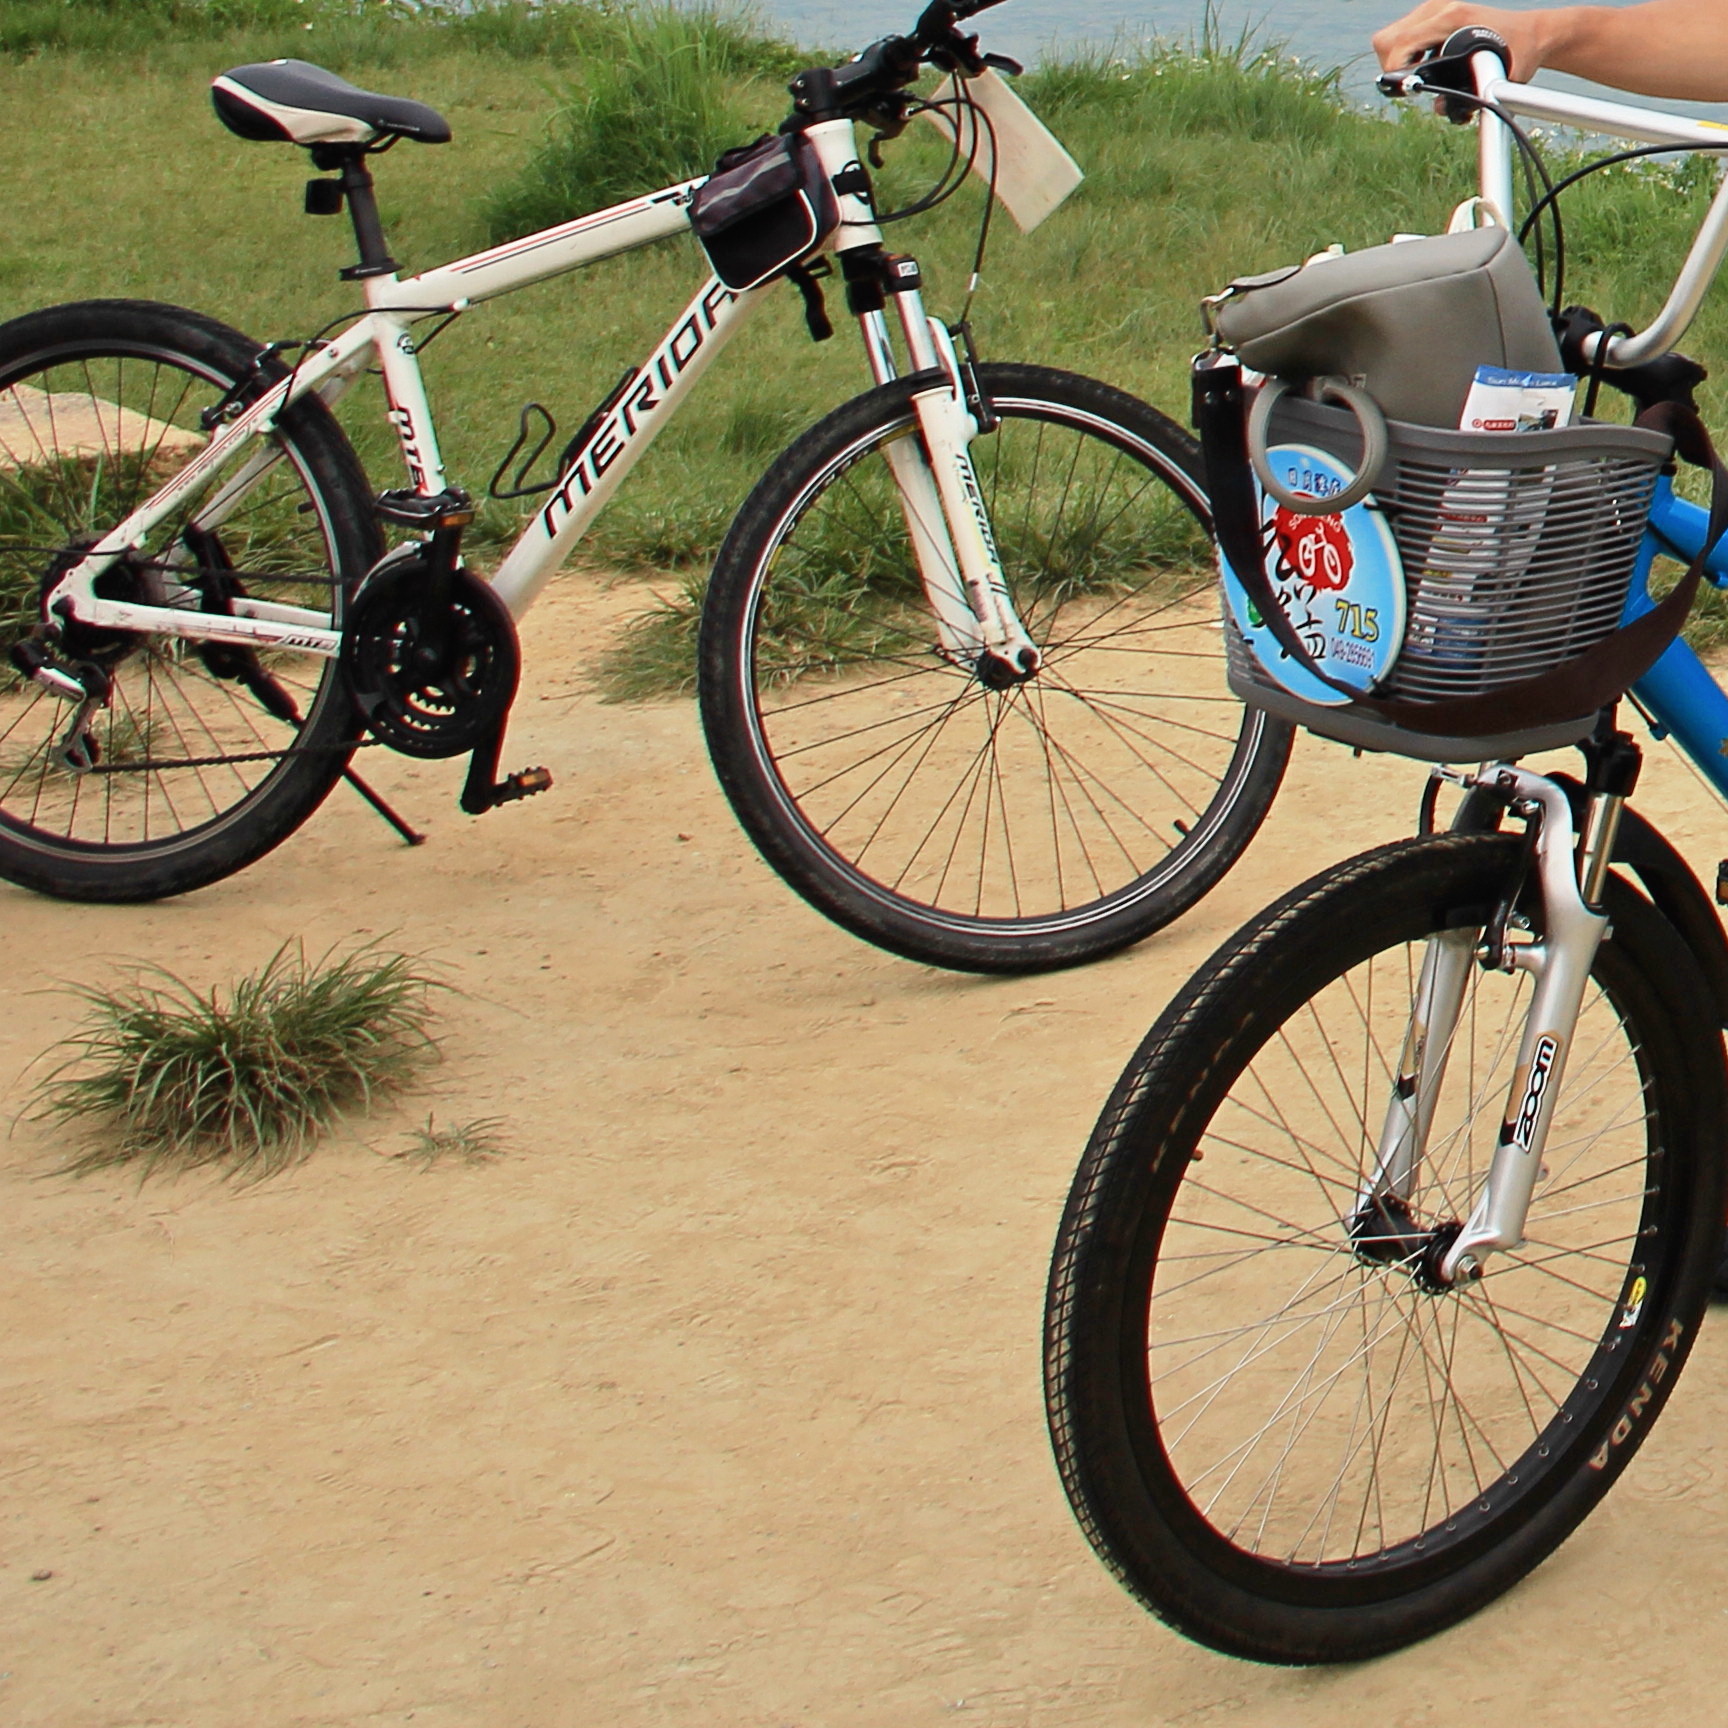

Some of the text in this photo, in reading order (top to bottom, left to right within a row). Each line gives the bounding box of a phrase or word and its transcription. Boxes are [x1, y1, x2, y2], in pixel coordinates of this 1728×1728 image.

[1335, 597, 1380, 643] 715
[1514, 1036, 1557, 1152] ZOOM
[1587, 1318, 1684, 1471] KENDA
